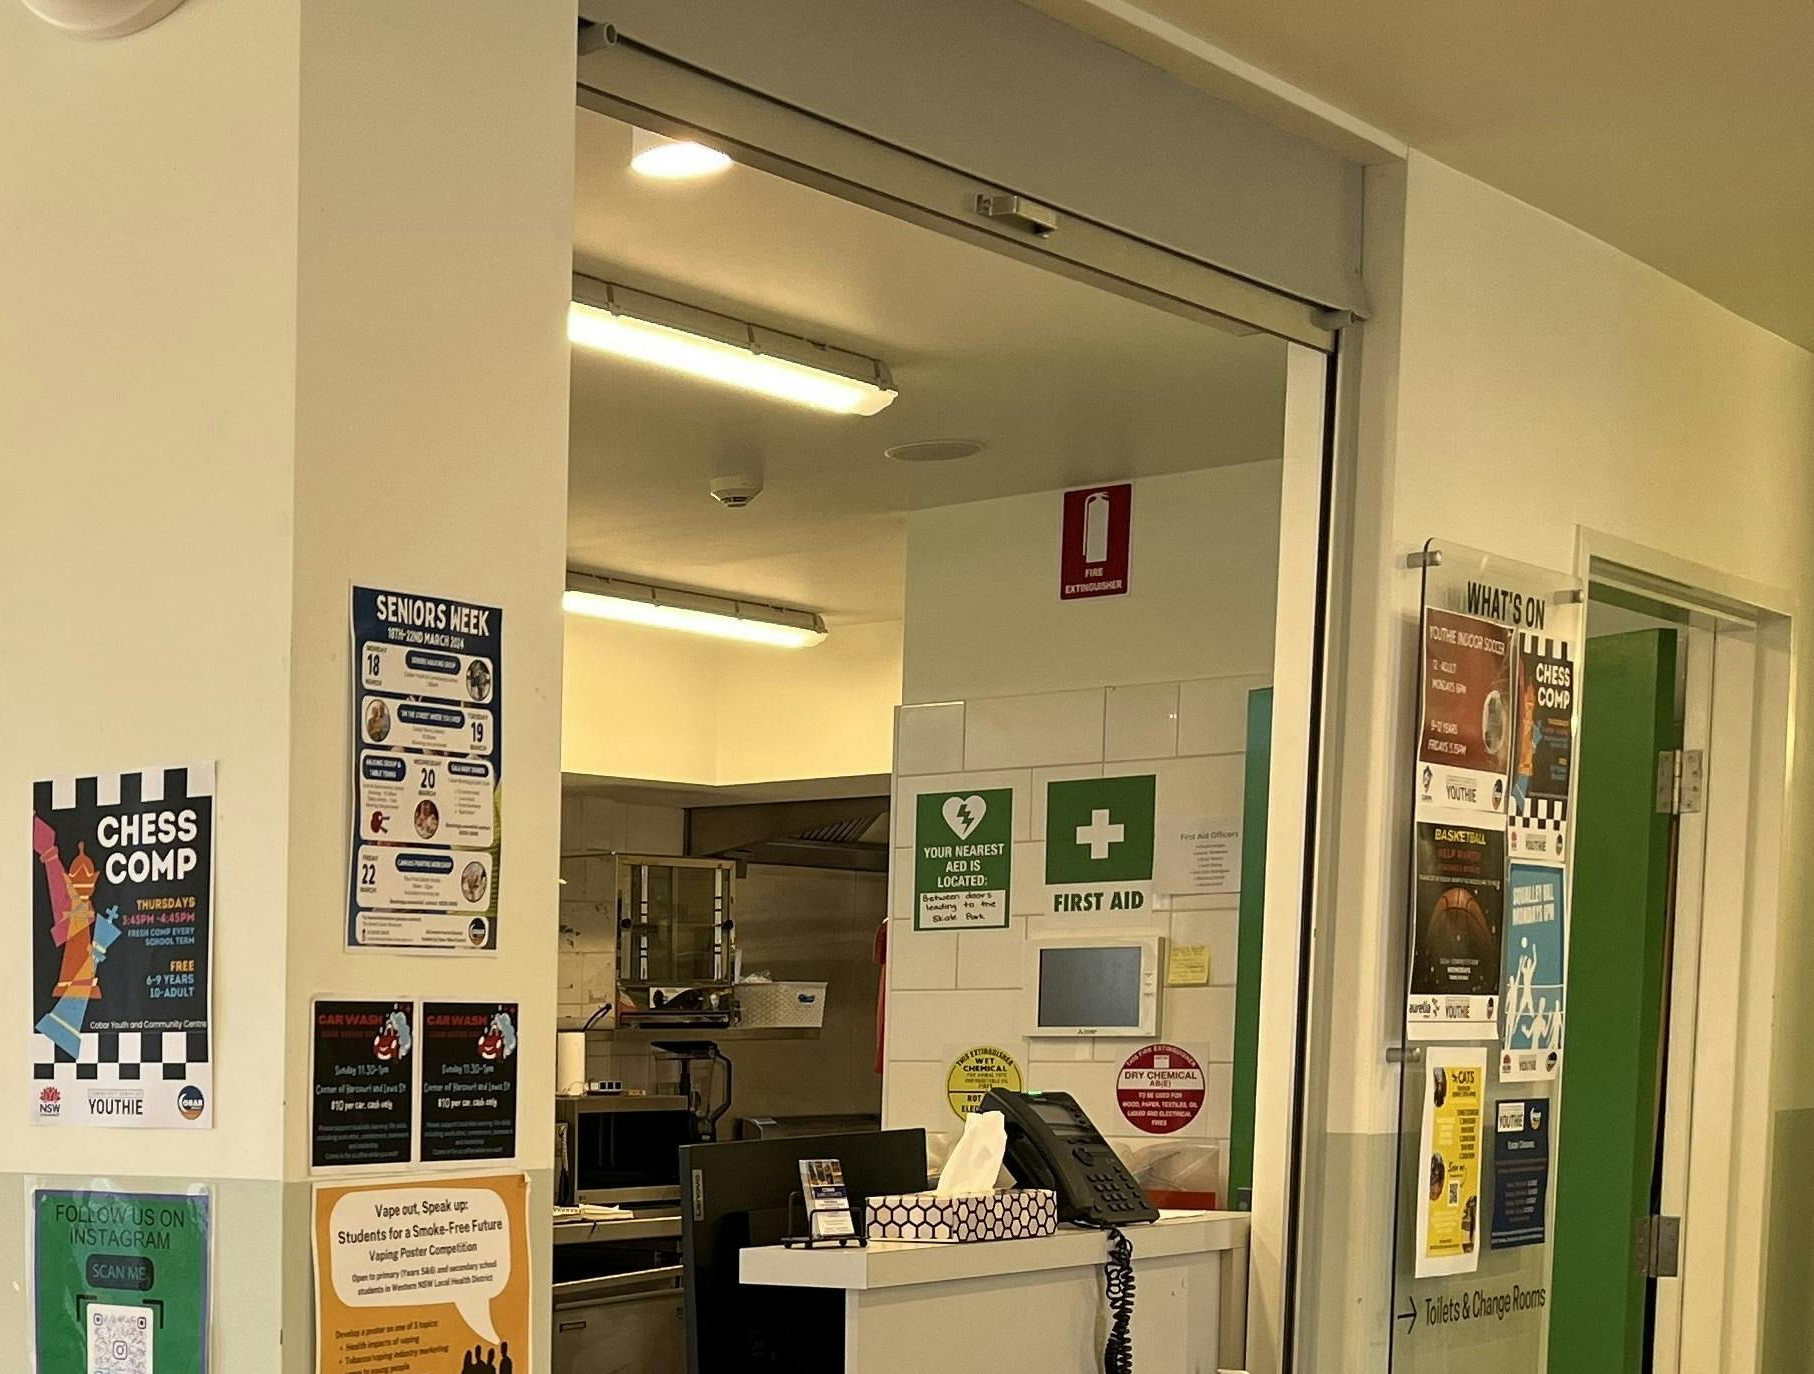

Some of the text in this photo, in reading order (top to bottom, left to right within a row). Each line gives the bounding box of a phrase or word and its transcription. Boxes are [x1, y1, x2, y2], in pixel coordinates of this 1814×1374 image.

[1085, 568, 1104, 578] FIRE
[1065, 580, 1122, 594] EXTINGUISHER
[1467, 581, 1545, 630] WHAT'S ON
[376, 594, 490, 637] SENIORS WEEK
[424, 632, 449, 647] MARCH
[367, 653, 380, 676] 18
[1536, 662, 1571, 687] CHESS
[1537, 686, 1570, 709] COMP
[471, 722, 484, 743] 19
[420, 767, 436, 789] 20
[1446, 785, 1477, 803] YOUTHIE
[97, 809, 198, 849] CHESS
[1435, 828, 1486, 845] BASKETBALL
[924, 843, 1004, 859] YOUR NEAREST
[105, 848, 198, 885] COMP
[362, 864, 376, 885] 22
[945, 860, 981, 872] AED IS
[937, 875, 988, 888] LOCATED:
[136, 896, 196, 911] THURSDAYS
[1053, 890, 1144, 913] FIRST AID
[122, 914, 155, 926] 3:45PM
[128, 927, 195, 937] FRESH COMP EVERY
[145, 937, 195, 946] SCHOOL TERM
[170, 960, 194, 972] FREE
[146, 974, 194, 985] 6-9 YEARS
[150, 987, 194, 998] 10-ADULT
[90, 1021, 109, 1030] Cobar
[110, 1021, 129, 1029] Youth
[130, 1021, 143, 1029] and
[143, 1020, 182, 1030] Community
[1124, 1071, 1197, 1080] DRY CHEMICAL
[39, 1103, 61, 1113] NSW
[88, 1099, 144, 1115] YOUTHIE
[56, 1204, 185, 1228] FOLLOW US ON
[375, 1203, 400, 1219] Vape
[422, 1199, 451, 1215] Speak
[70, 1228, 171, 1250] INSTAGRAM
[338, 1219, 503, 1245] Students for a Smoke-Free Future
[369, 1241, 478, 1262] Vaping Poster Competition
[91, 1264, 146, 1280] SCAN ME
[1425, 1285, 1546, 1326] Toilets & Change Rooms
